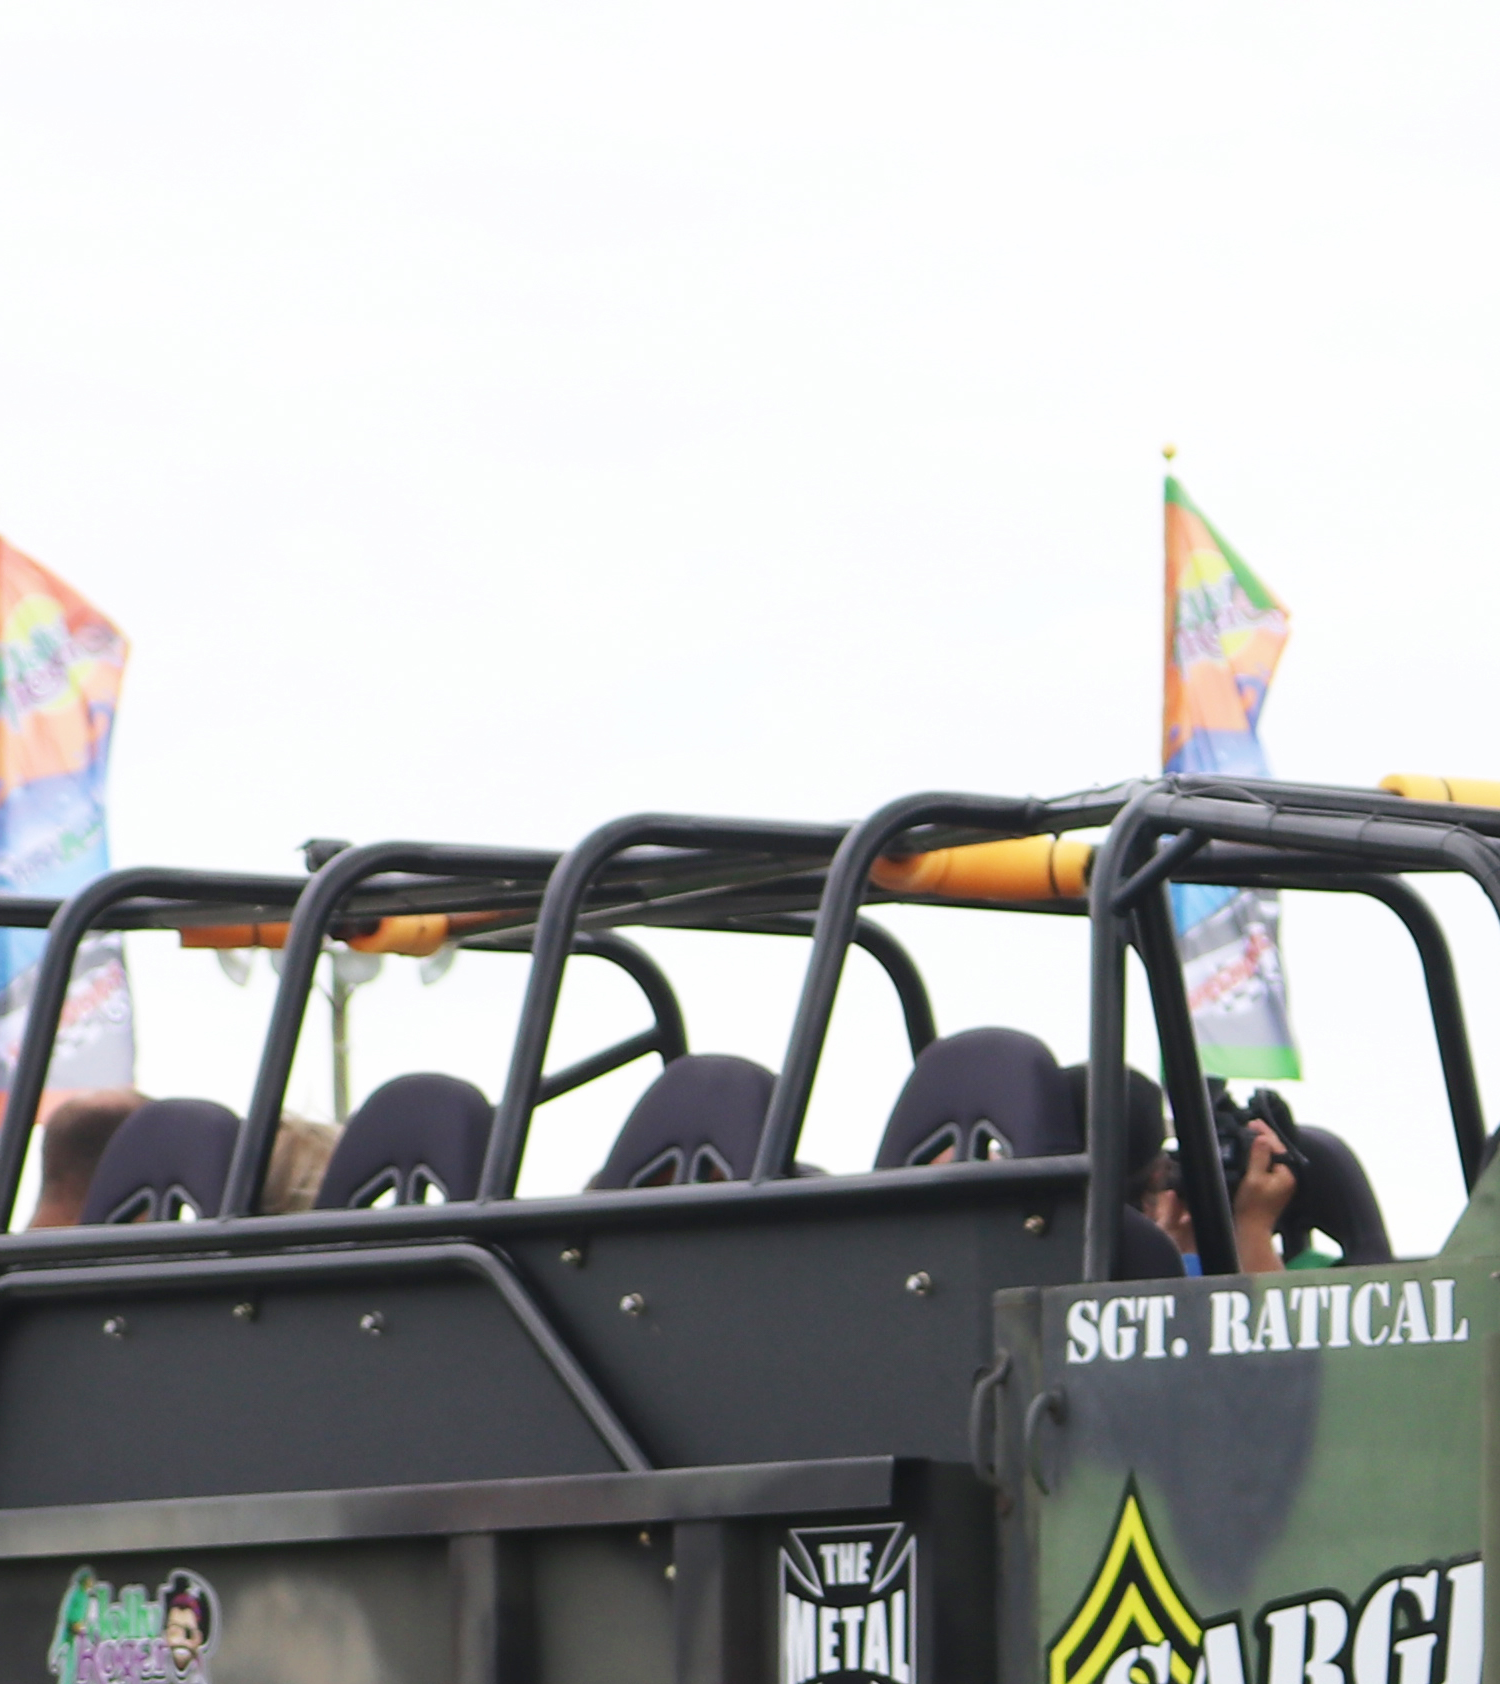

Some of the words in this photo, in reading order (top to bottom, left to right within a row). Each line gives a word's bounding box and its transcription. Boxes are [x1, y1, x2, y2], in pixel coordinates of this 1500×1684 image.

[1065, 1295, 1189, 1365] SGT.
[1208, 1278, 1470, 1356] RATICAL
[818, 1540, 873, 1585] THE
